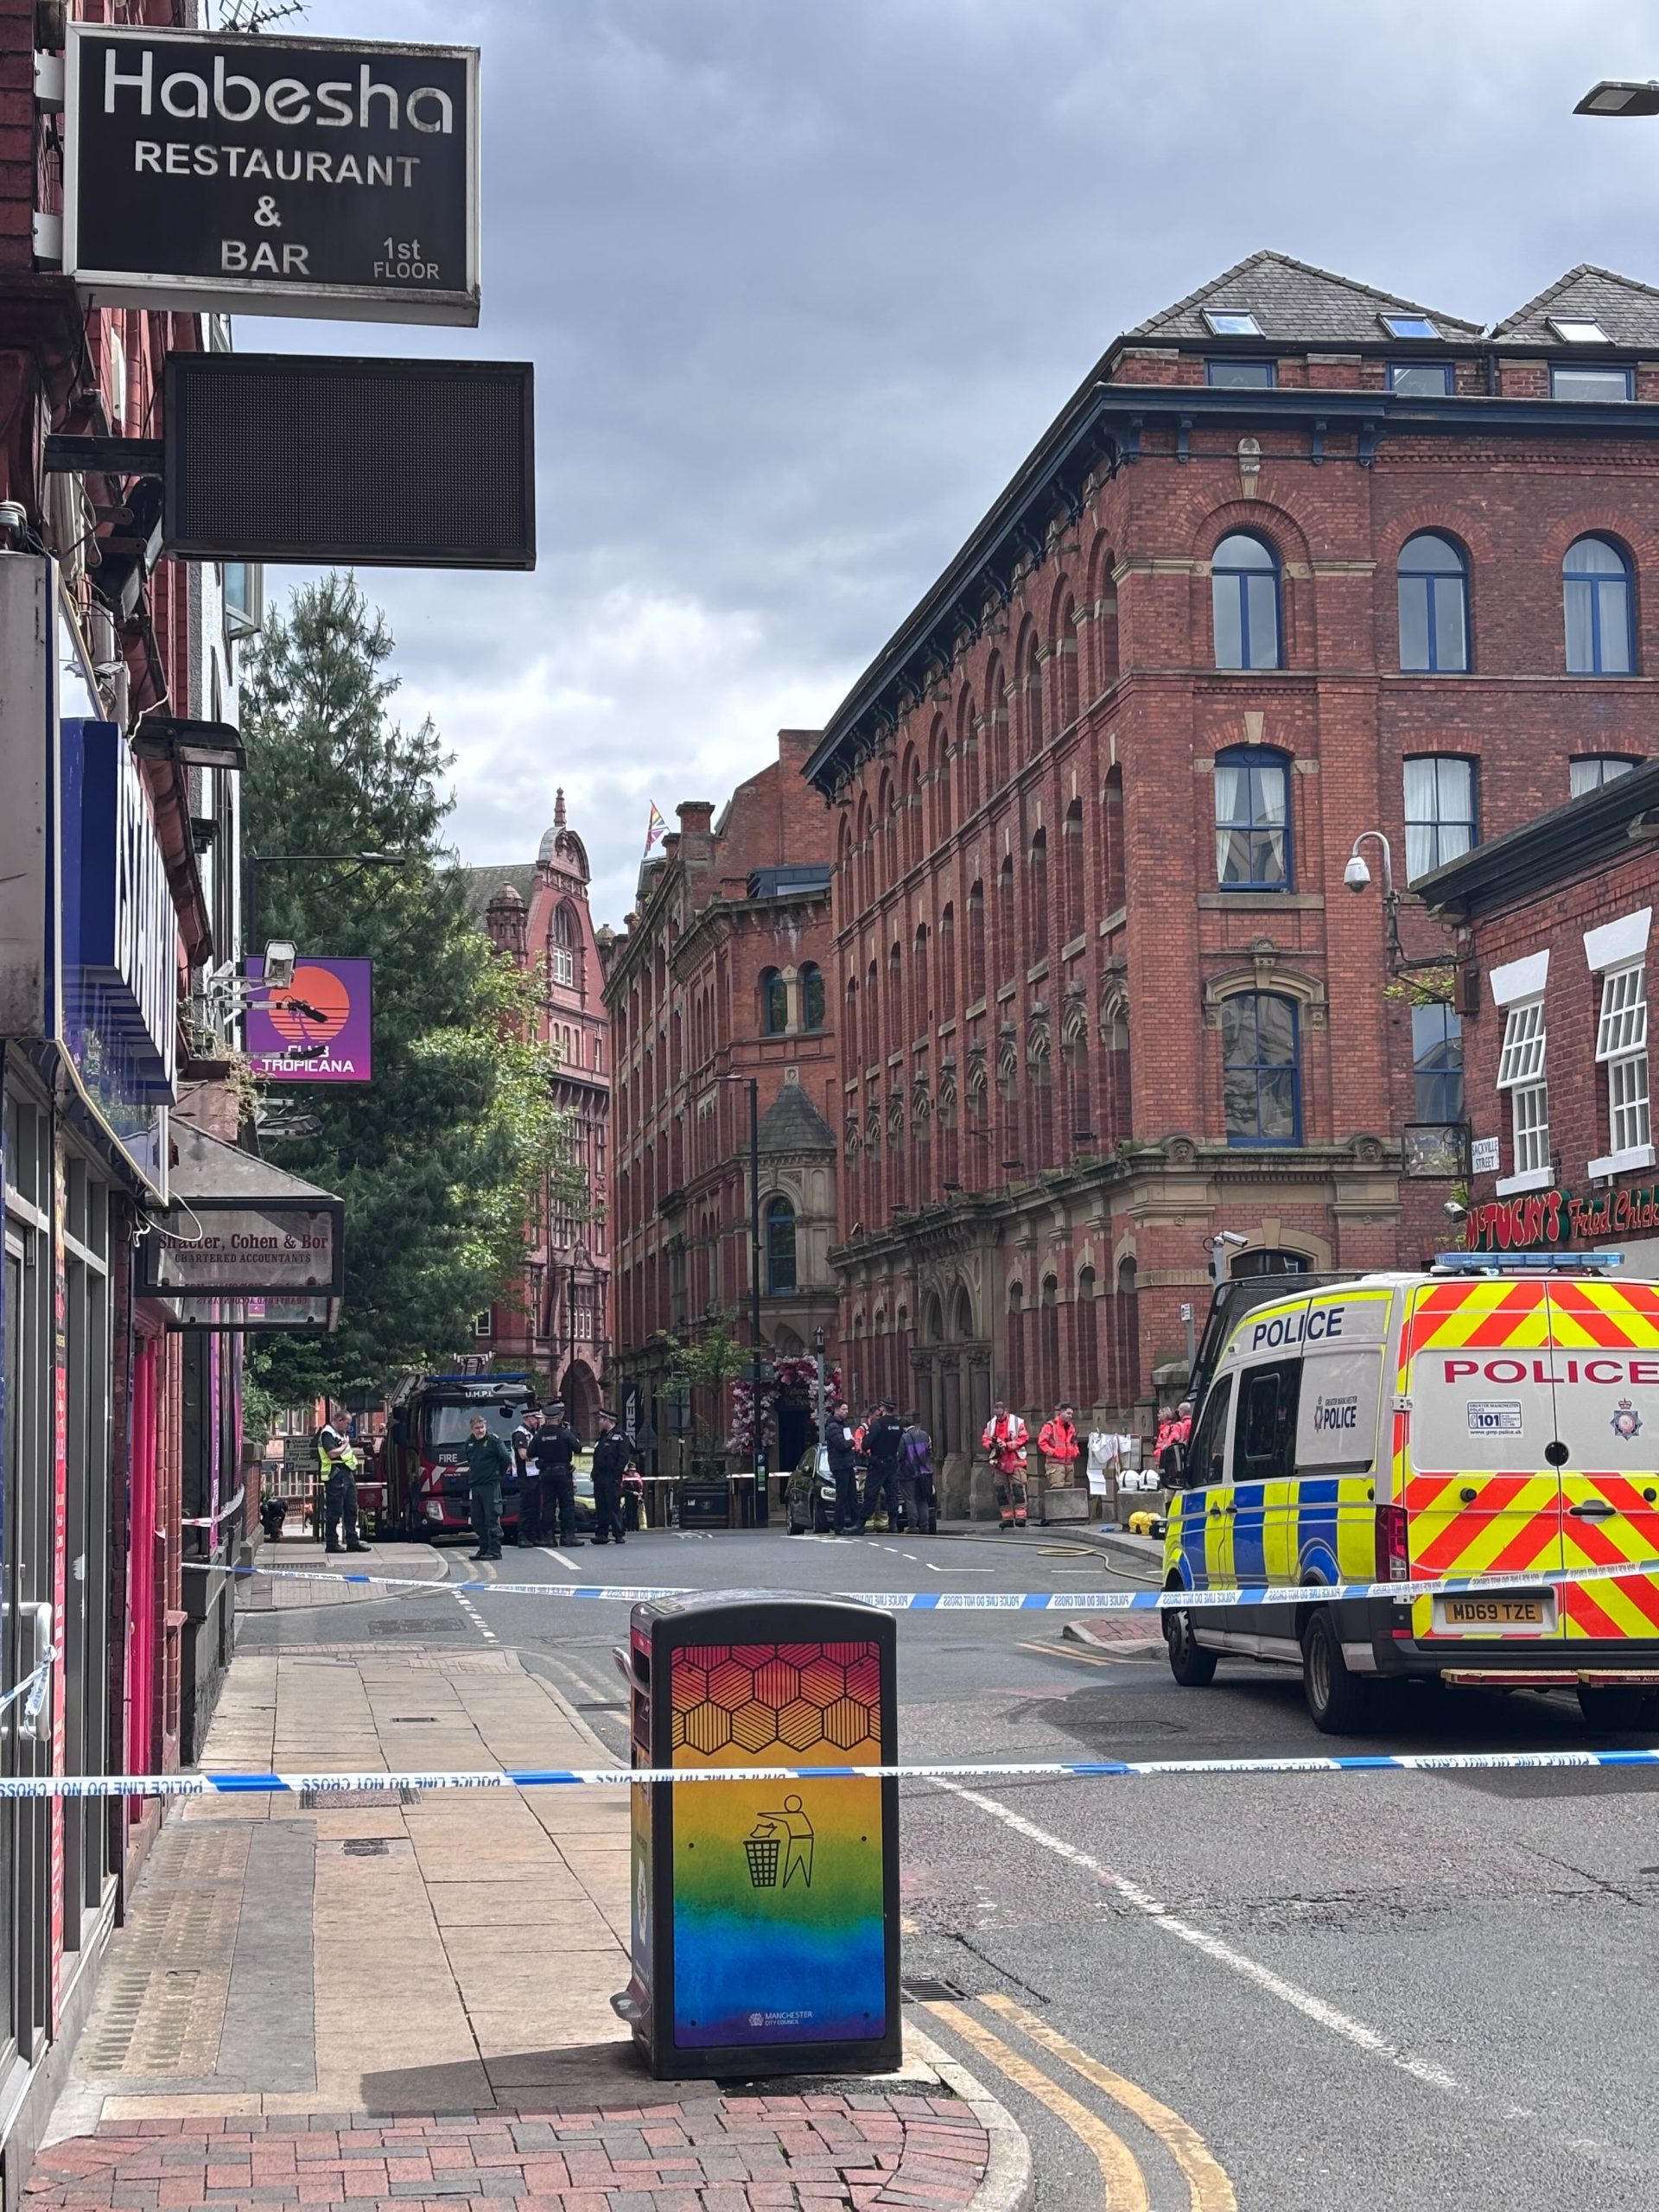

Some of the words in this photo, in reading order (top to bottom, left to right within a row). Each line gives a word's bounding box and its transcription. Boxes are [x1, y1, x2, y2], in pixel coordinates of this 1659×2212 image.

[105, 48, 454, 134] Habesha
[134, 140, 421, 188] RESTAURANT
[254, 195, 282, 228] &
[383, 238, 421, 261] 1st
[220, 240, 311, 276] BAR
[373, 261, 440, 280] FLOOR
[262, 1058, 355, 1072] TROPICANA
[1471, 1141, 1498, 1156] SACKVILLE
[1476, 1155, 1494, 1169] STREET
[1568, 1193, 1611, 1238] Fried
[231, 1234, 277, 1249] Cohen
[283, 1235, 296, 1249] &
[301, 1234, 328, 1249] Bor
[175, 1254, 236, 1263] CHARTERED
[239, 1254, 312, 1263] ACCOUNTANTS
[1253, 1307, 1344, 1351] POLICE
[1444, 1360, 1659, 1383] POLICE
[1324, 1406, 1357, 1429] POLICE
[1478, 1414, 1499, 1427] 101
[438, 1453, 458, 1463] FIRE
[1452, 1602, 1497, 1622] MD69
[1502, 1602, 1537, 1621] TZE
[54, 1782, 82, 1796] NOT
[87, 1782, 109, 1796] DO
[113, 1782, 146, 1796] LINE
[151, 1780, 203, 1795] POLICE
[302, 1778, 351, 1791] CROSS
[415, 1777, 446, 1789] LINE
[450, 1776, 501, 1788] POLICE
[765, 2011, 812, 2019] MANCHESTER
